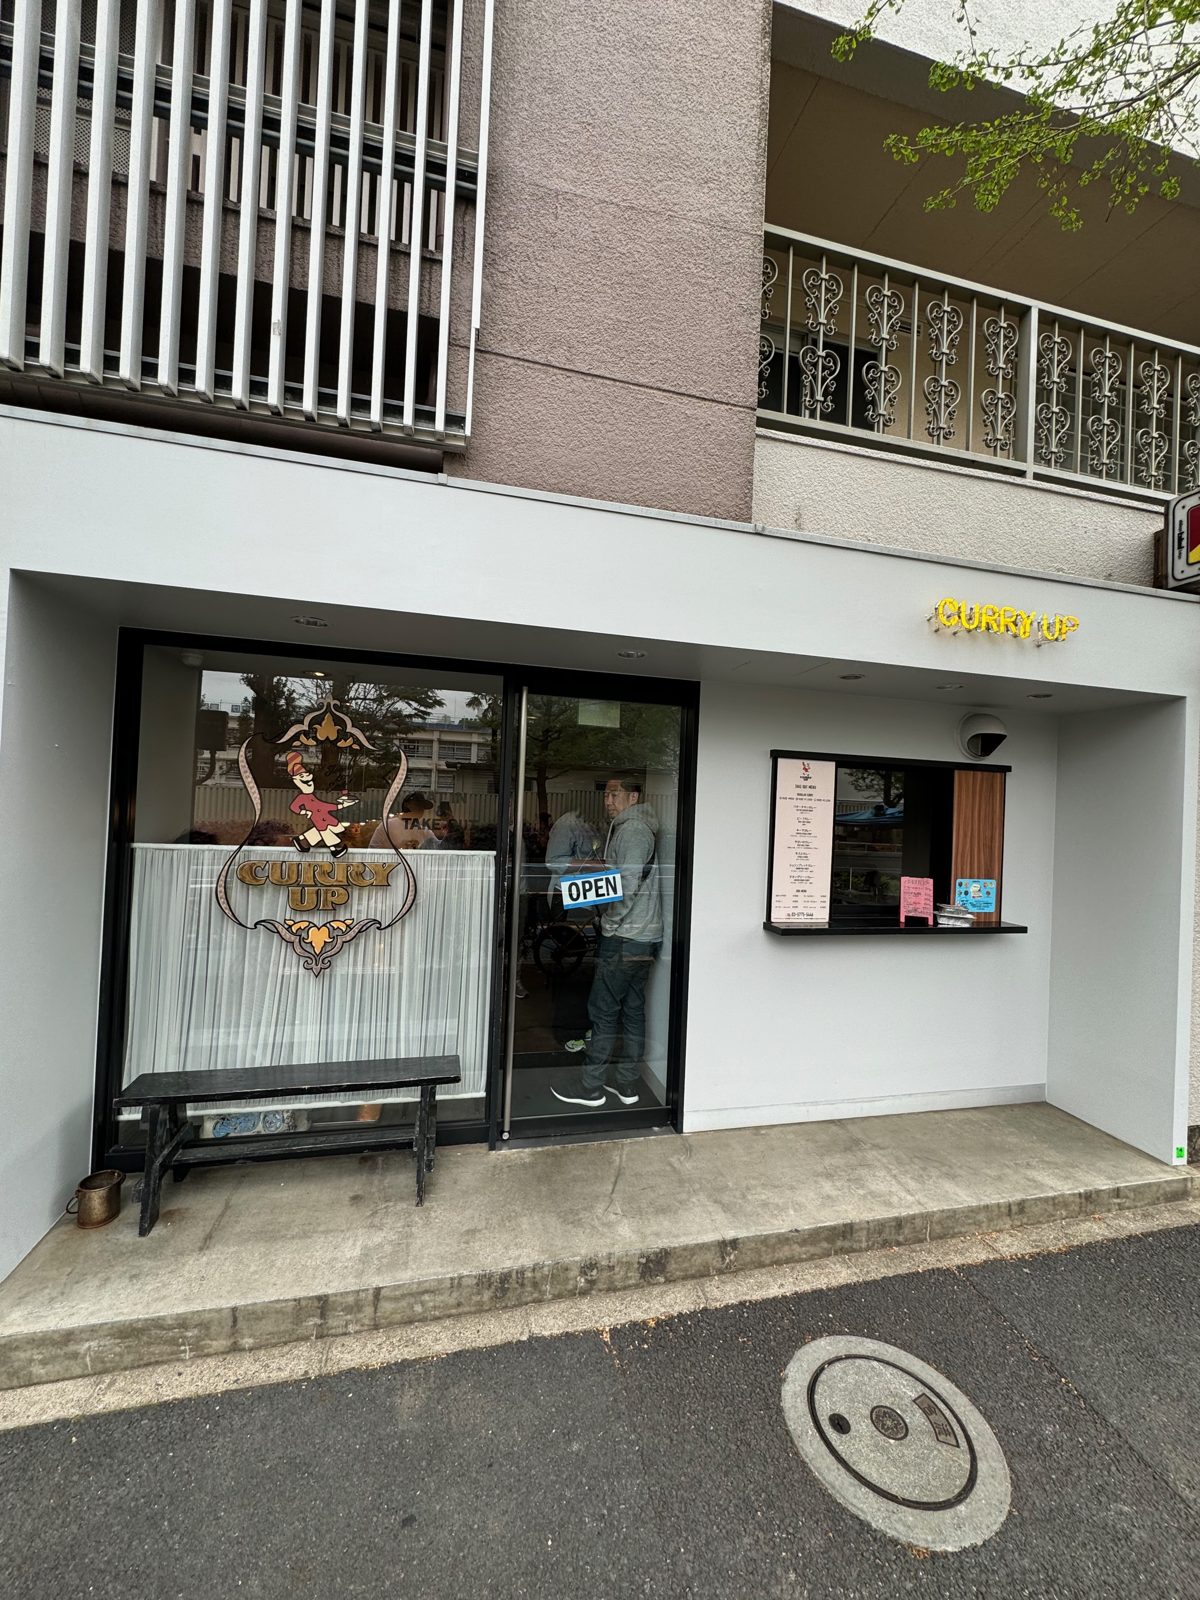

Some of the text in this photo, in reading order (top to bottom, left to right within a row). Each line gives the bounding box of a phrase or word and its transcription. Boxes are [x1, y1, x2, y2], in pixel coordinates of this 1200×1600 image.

[938, 597, 1080, 641] CURRY UP
[401, 817, 441, 830] TAKE
[236, 860, 401, 887] CURRY
[288, 886, 349, 911] UP
[568, 876, 618, 902] OPEN
